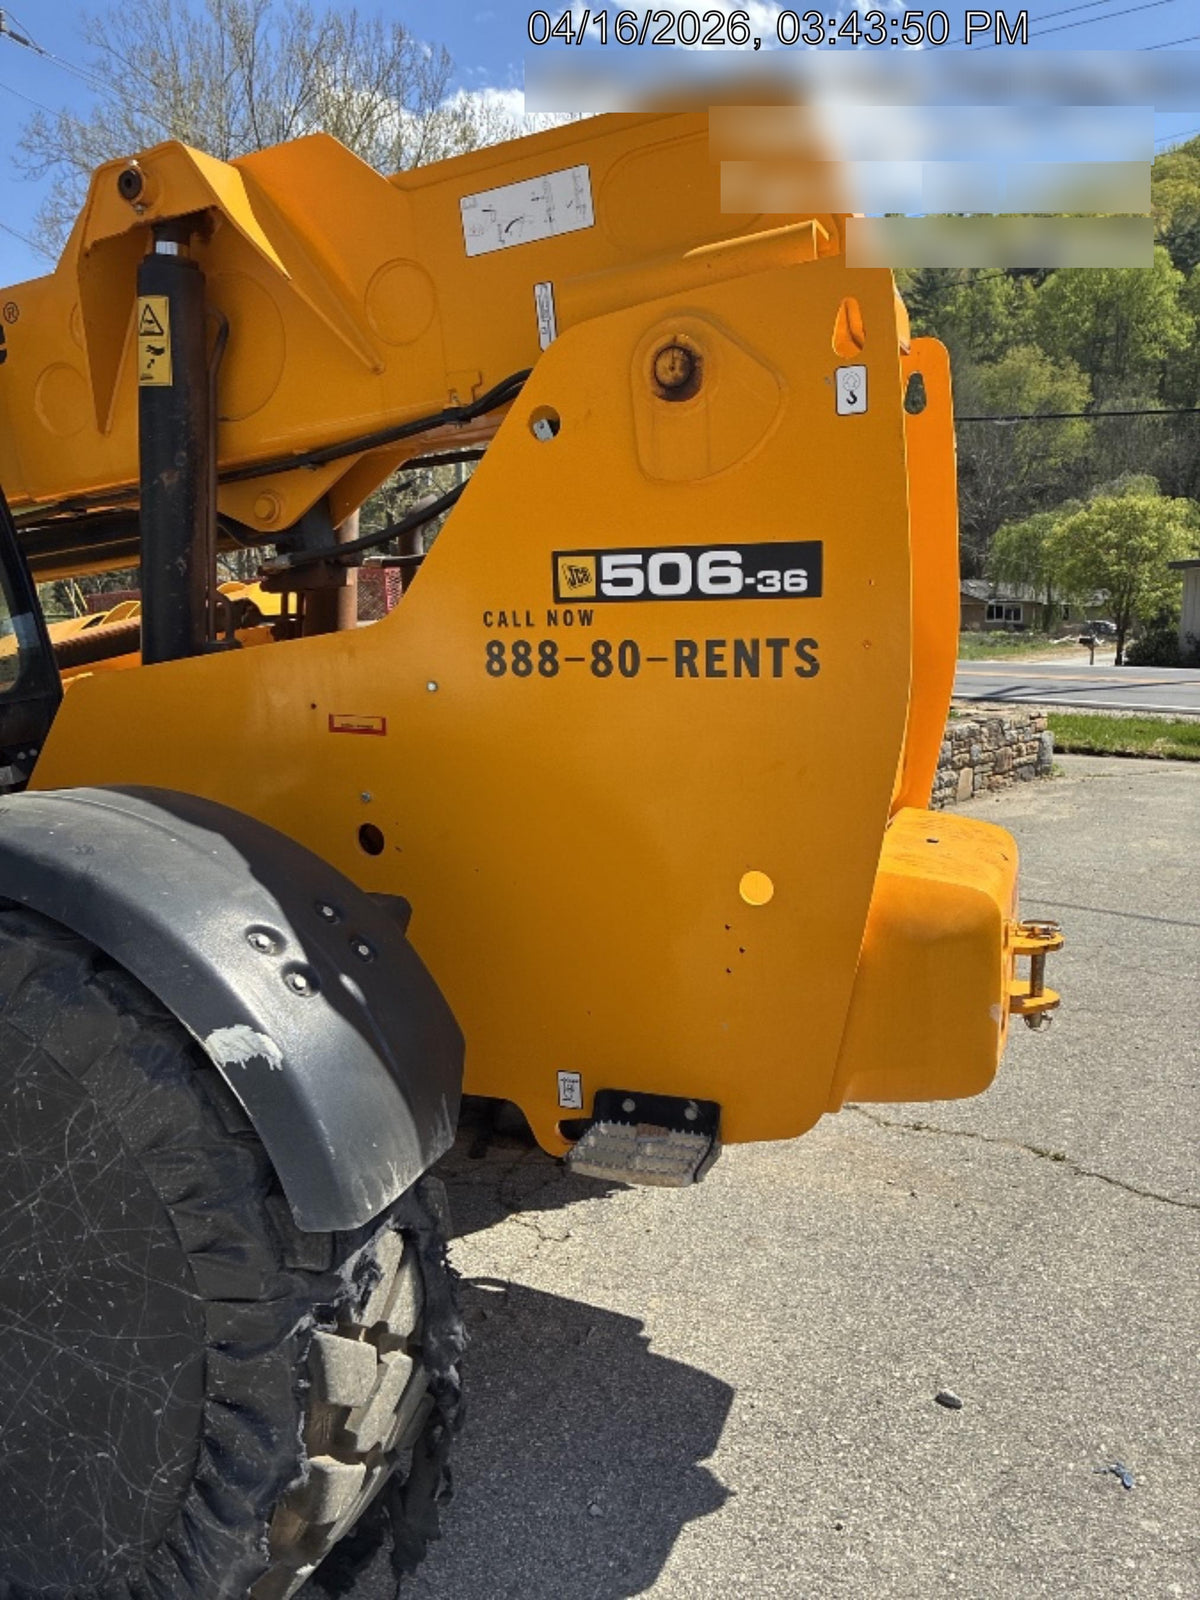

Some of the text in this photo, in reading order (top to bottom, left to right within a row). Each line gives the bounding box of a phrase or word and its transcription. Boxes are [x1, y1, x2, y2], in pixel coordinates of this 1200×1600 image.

[600, 551, 808, 597] 506-36
[483, 609, 594, 628] CALL NOW
